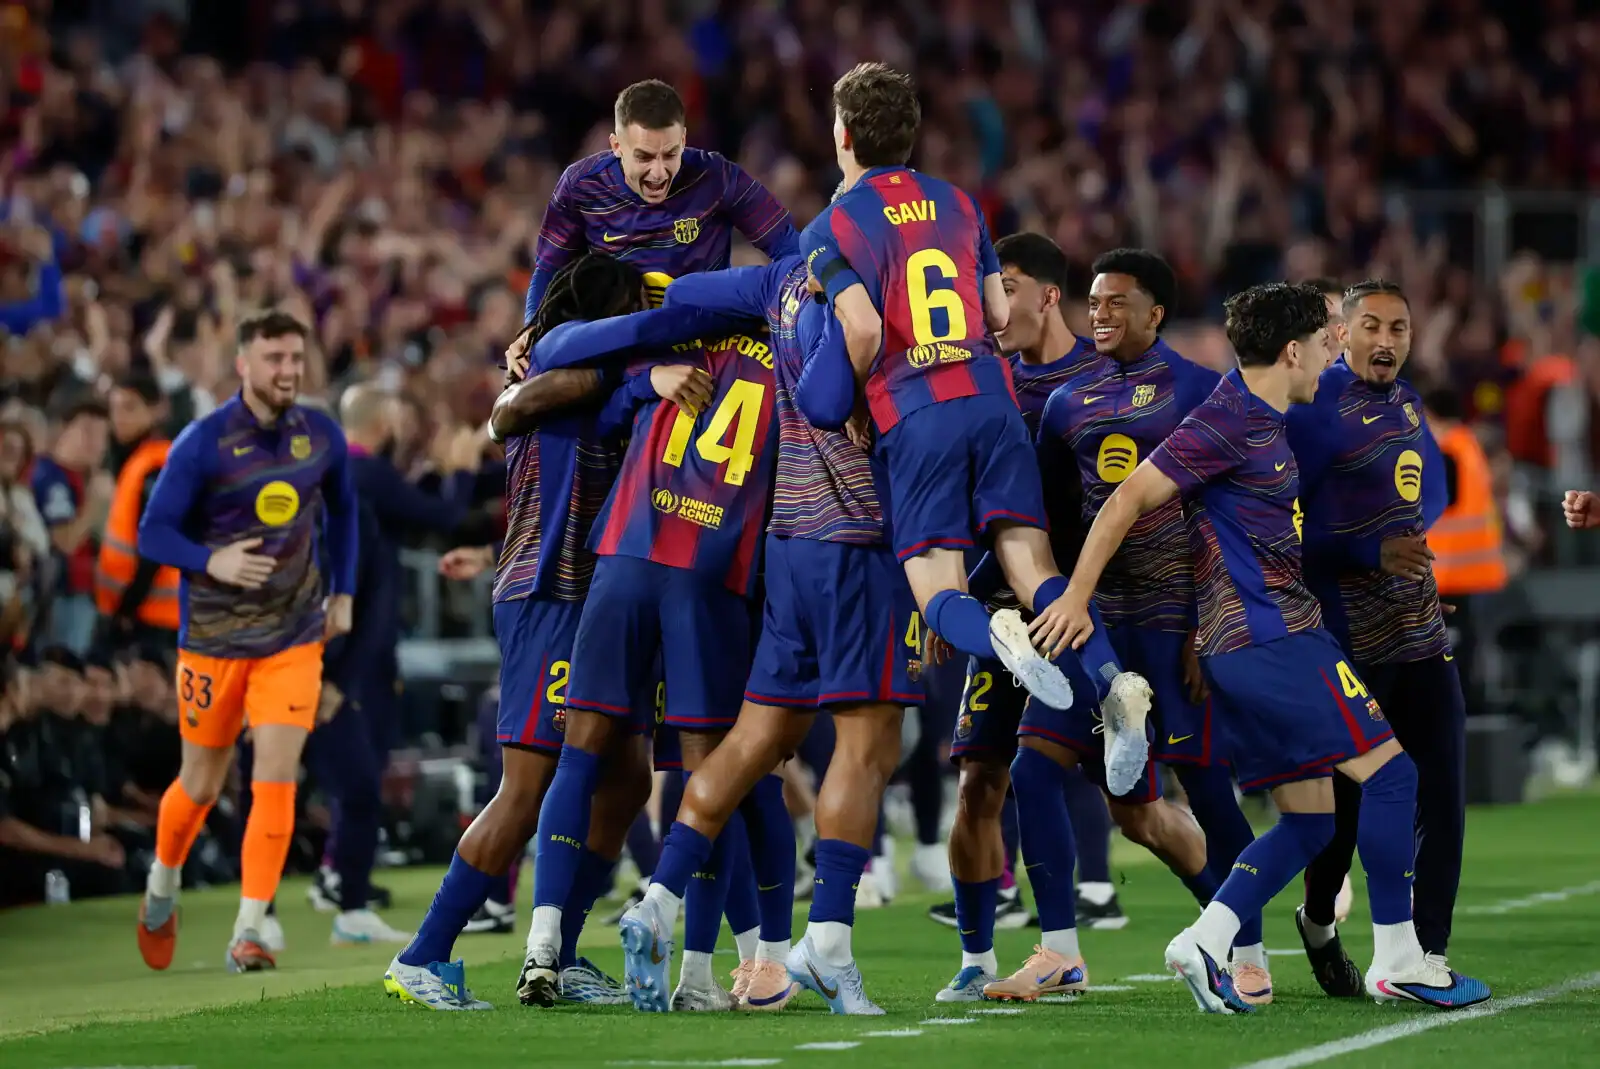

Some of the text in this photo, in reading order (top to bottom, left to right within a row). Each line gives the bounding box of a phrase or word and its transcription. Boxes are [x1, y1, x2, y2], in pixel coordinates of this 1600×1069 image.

[883, 200, 937, 226] GAVI
[906, 248, 967, 346] 6
[936, 342, 972, 359] UNHCR
[662, 368, 765, 487] 14
[677, 506, 721, 527] ACNUR
[681, 496, 724, 517] UNHCR
[904, 611, 921, 656] 4
[180, 667, 212, 709] 33
